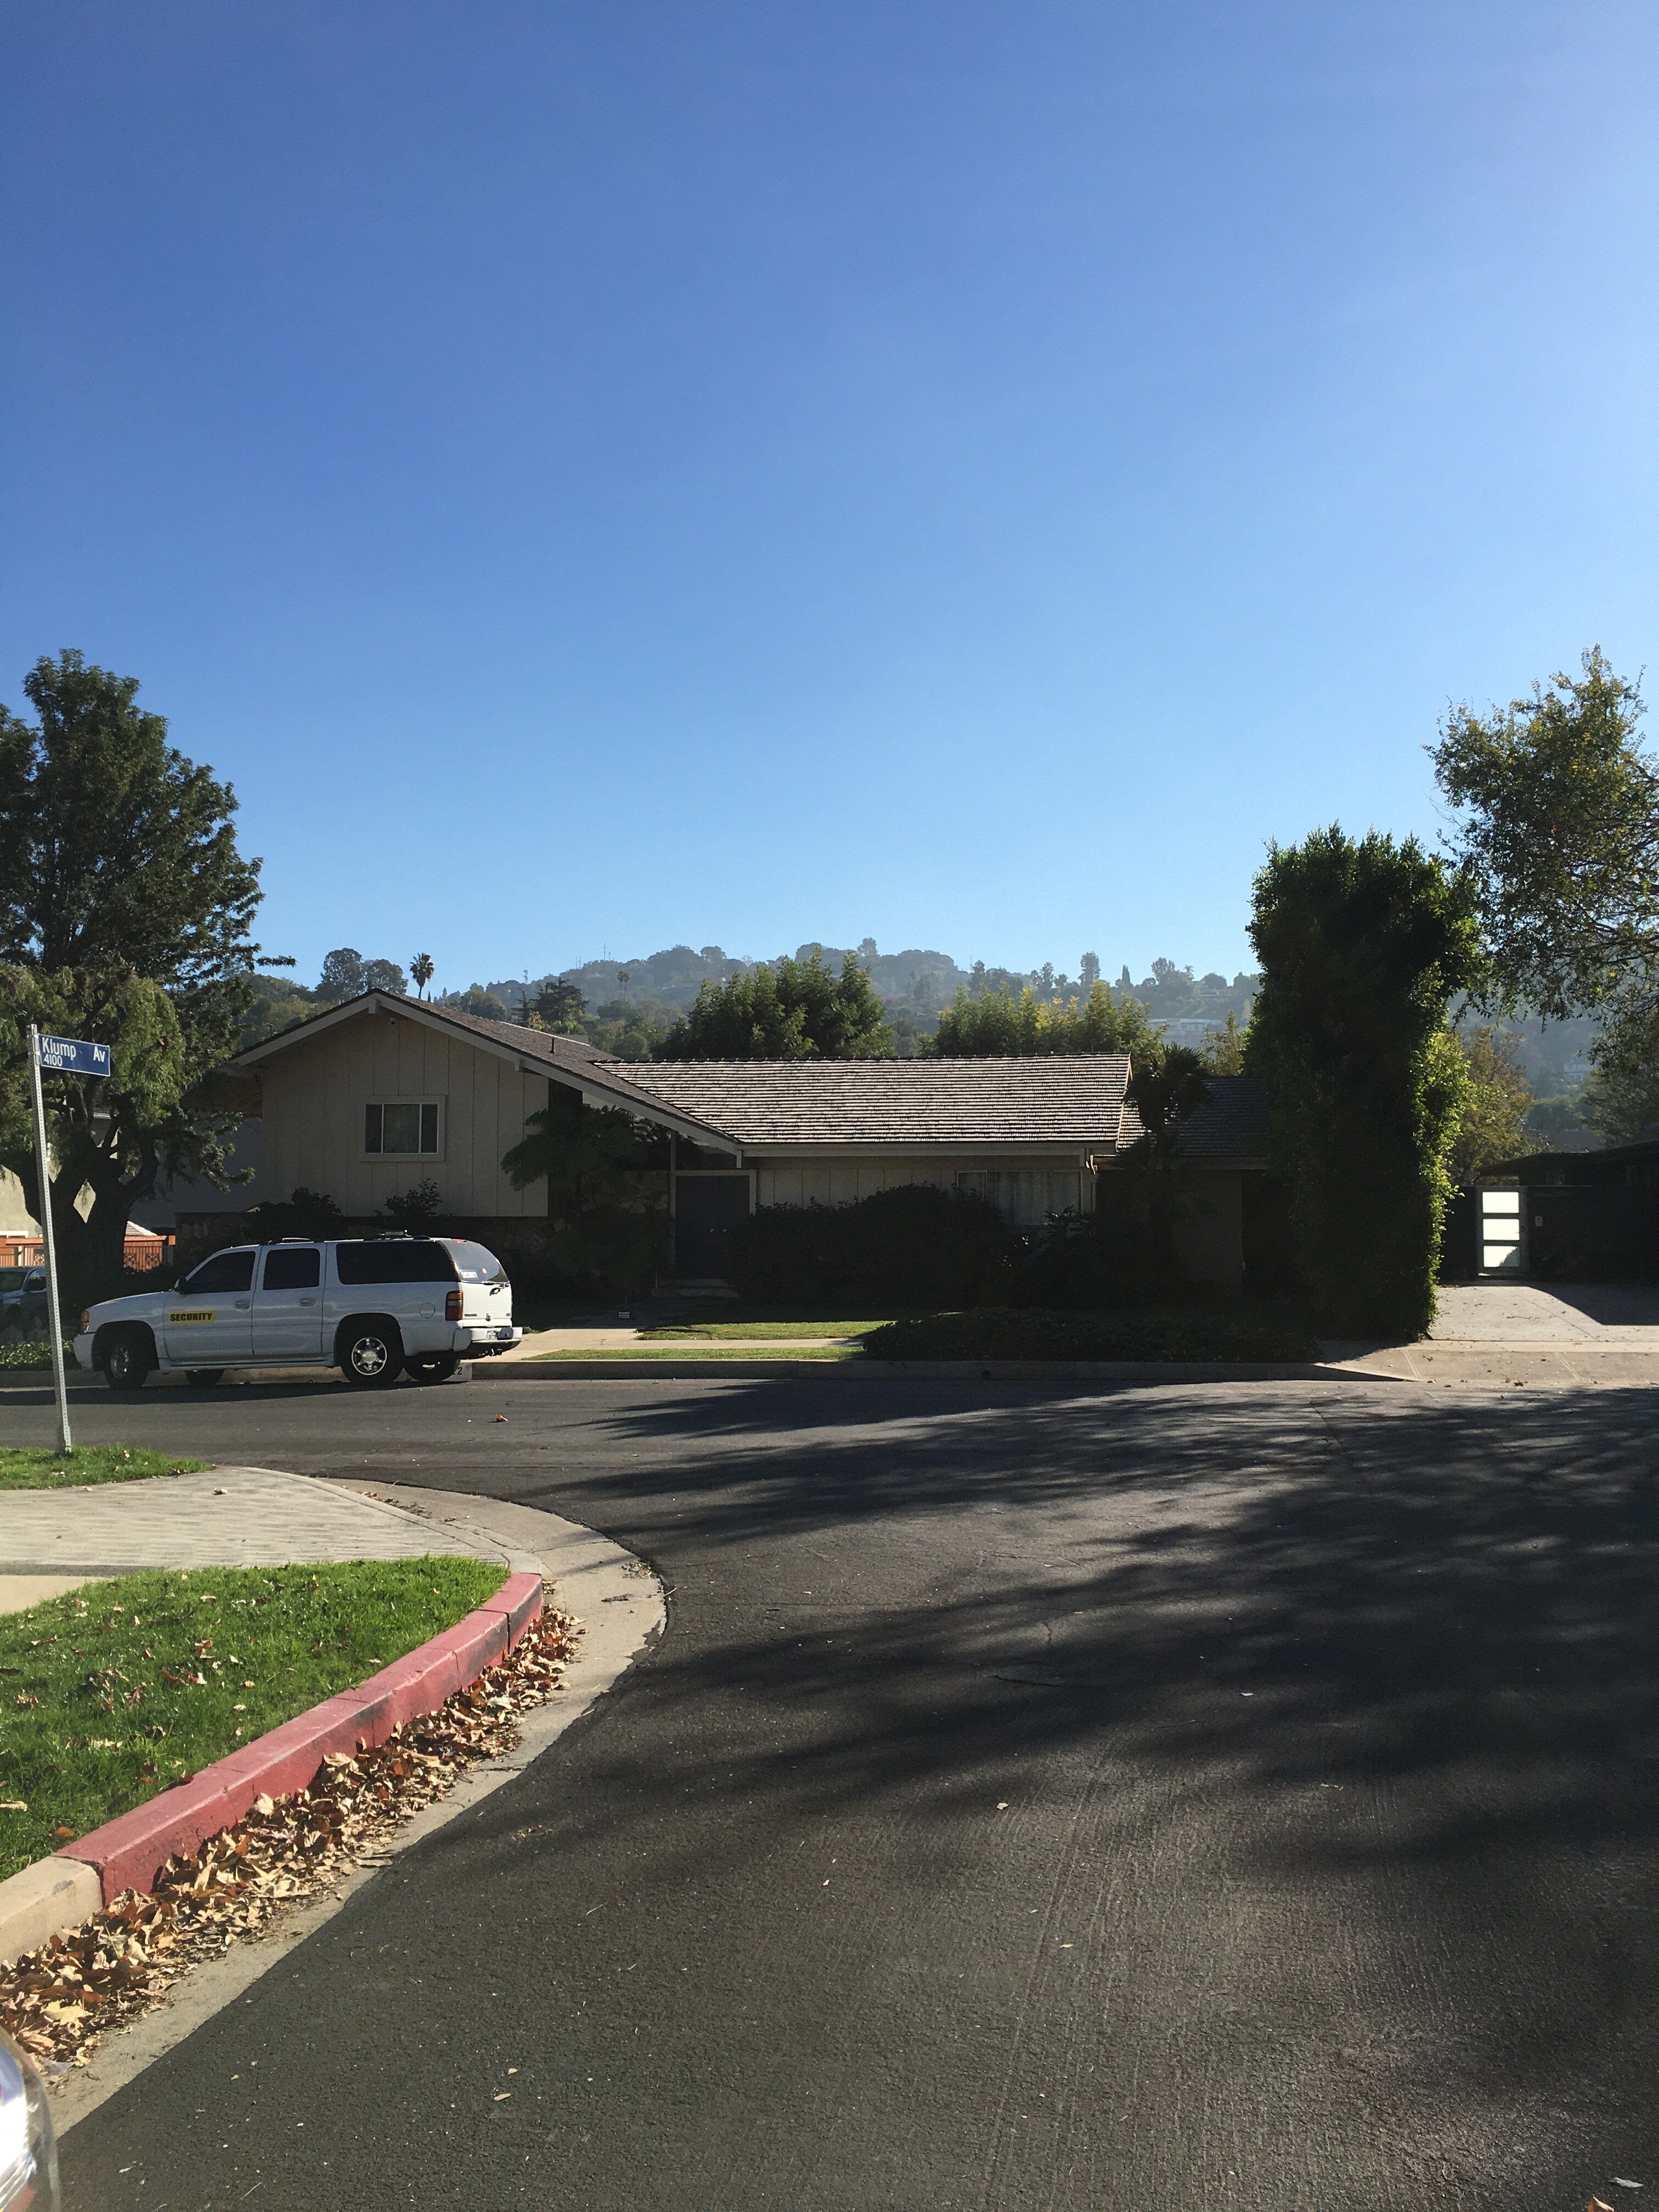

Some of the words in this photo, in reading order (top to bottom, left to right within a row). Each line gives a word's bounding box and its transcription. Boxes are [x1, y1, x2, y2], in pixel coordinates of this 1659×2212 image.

[42, 1037, 76, 1061] Klump
[93, 1046, 105, 1063] Av
[43, 1053, 63, 1066] 4100
[170, 1312, 212, 1322] SECURITY
